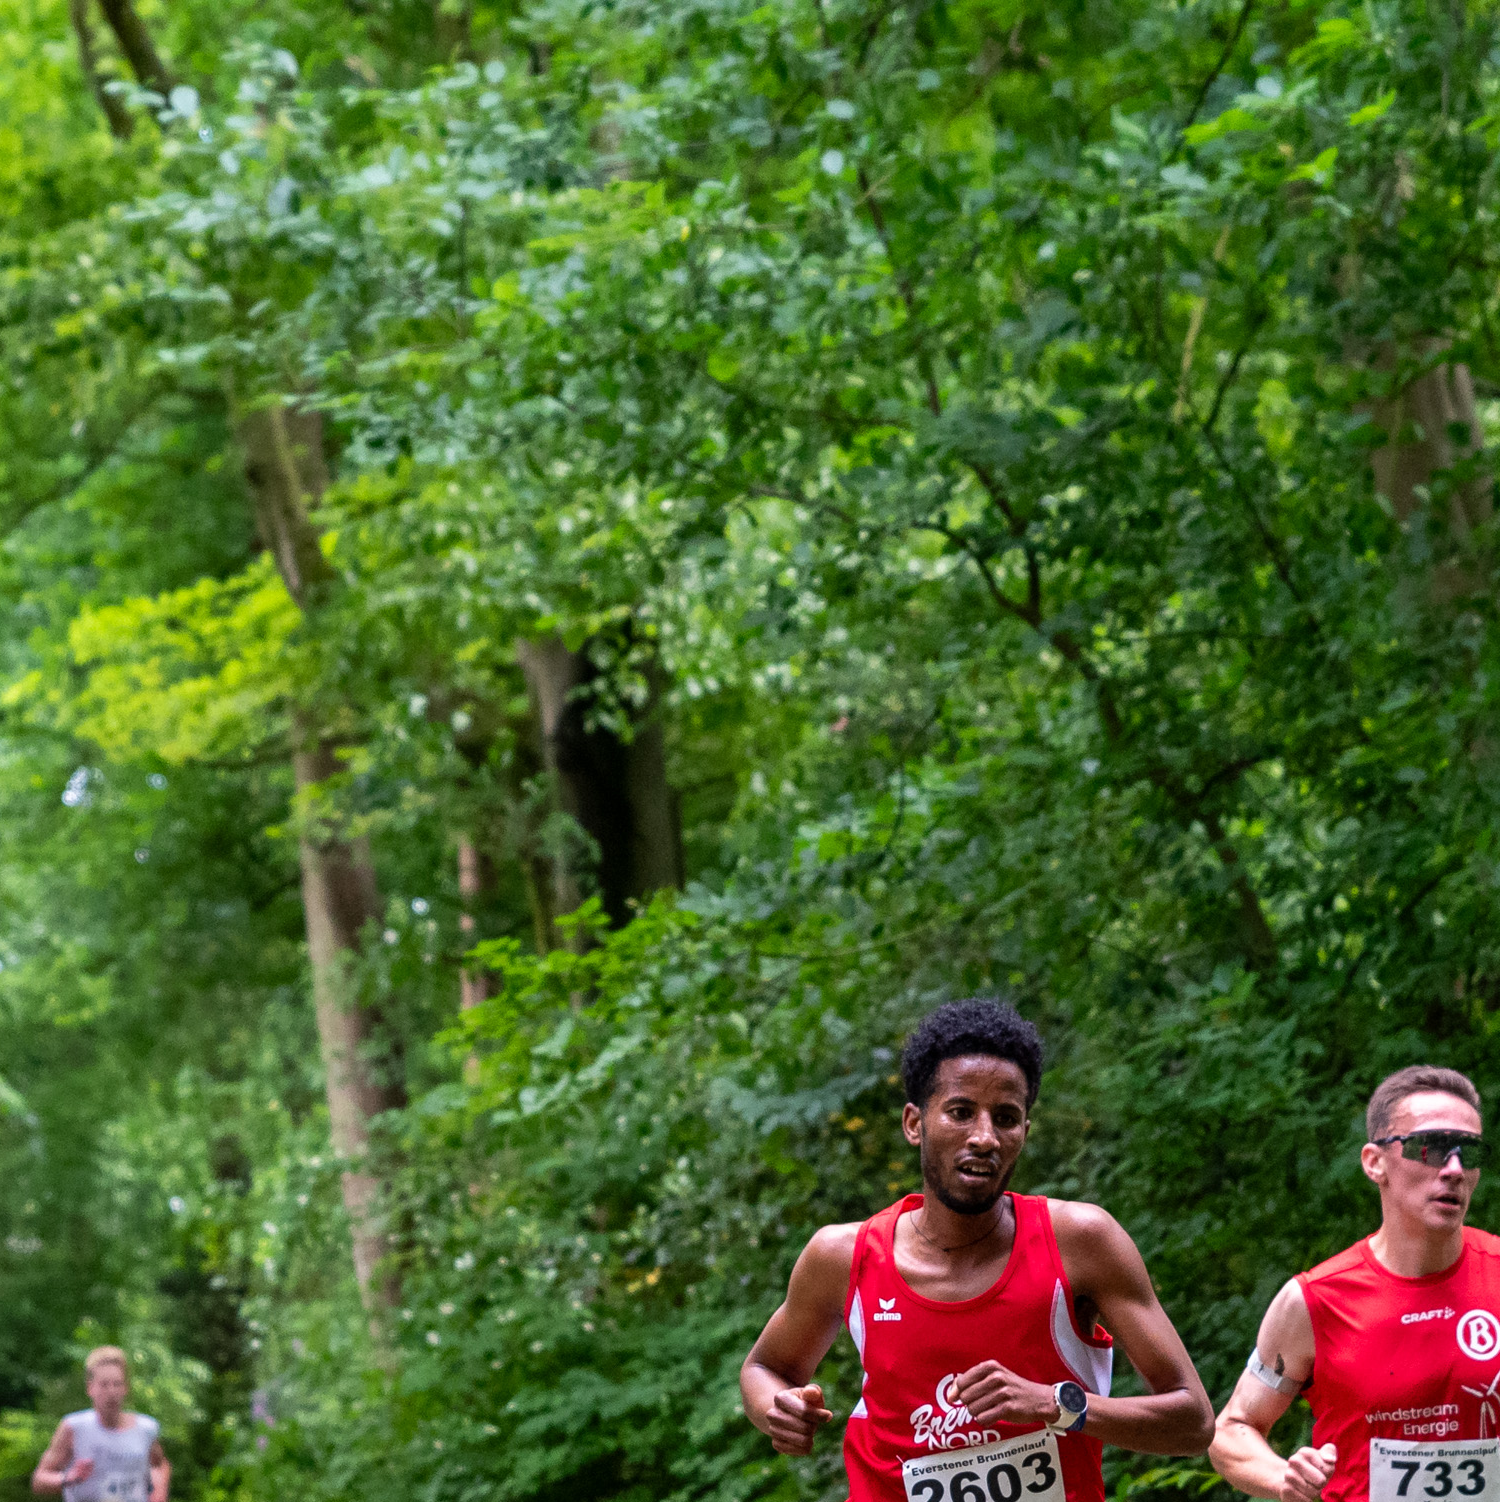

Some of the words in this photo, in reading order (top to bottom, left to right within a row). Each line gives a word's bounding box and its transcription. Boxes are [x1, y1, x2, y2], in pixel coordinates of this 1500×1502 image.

[873, 1311, 902, 1321] erima
[1401, 1309, 1444, 1325] CRAFT
[1365, 1404, 1459, 1424] windstream
[1403, 1419, 1459, 1437] Energie
[928, 1429, 1001, 1451] NORD
[911, 1458, 974, 1477] Everstener
[977, 1438, 1047, 1465] Brunnenlauf
[1380, 1447, 1435, 1457] Everstener
[1438, 1446, 1497, 1457] Brunnenlauf
[1391, 1459, 1486, 1497] 733
